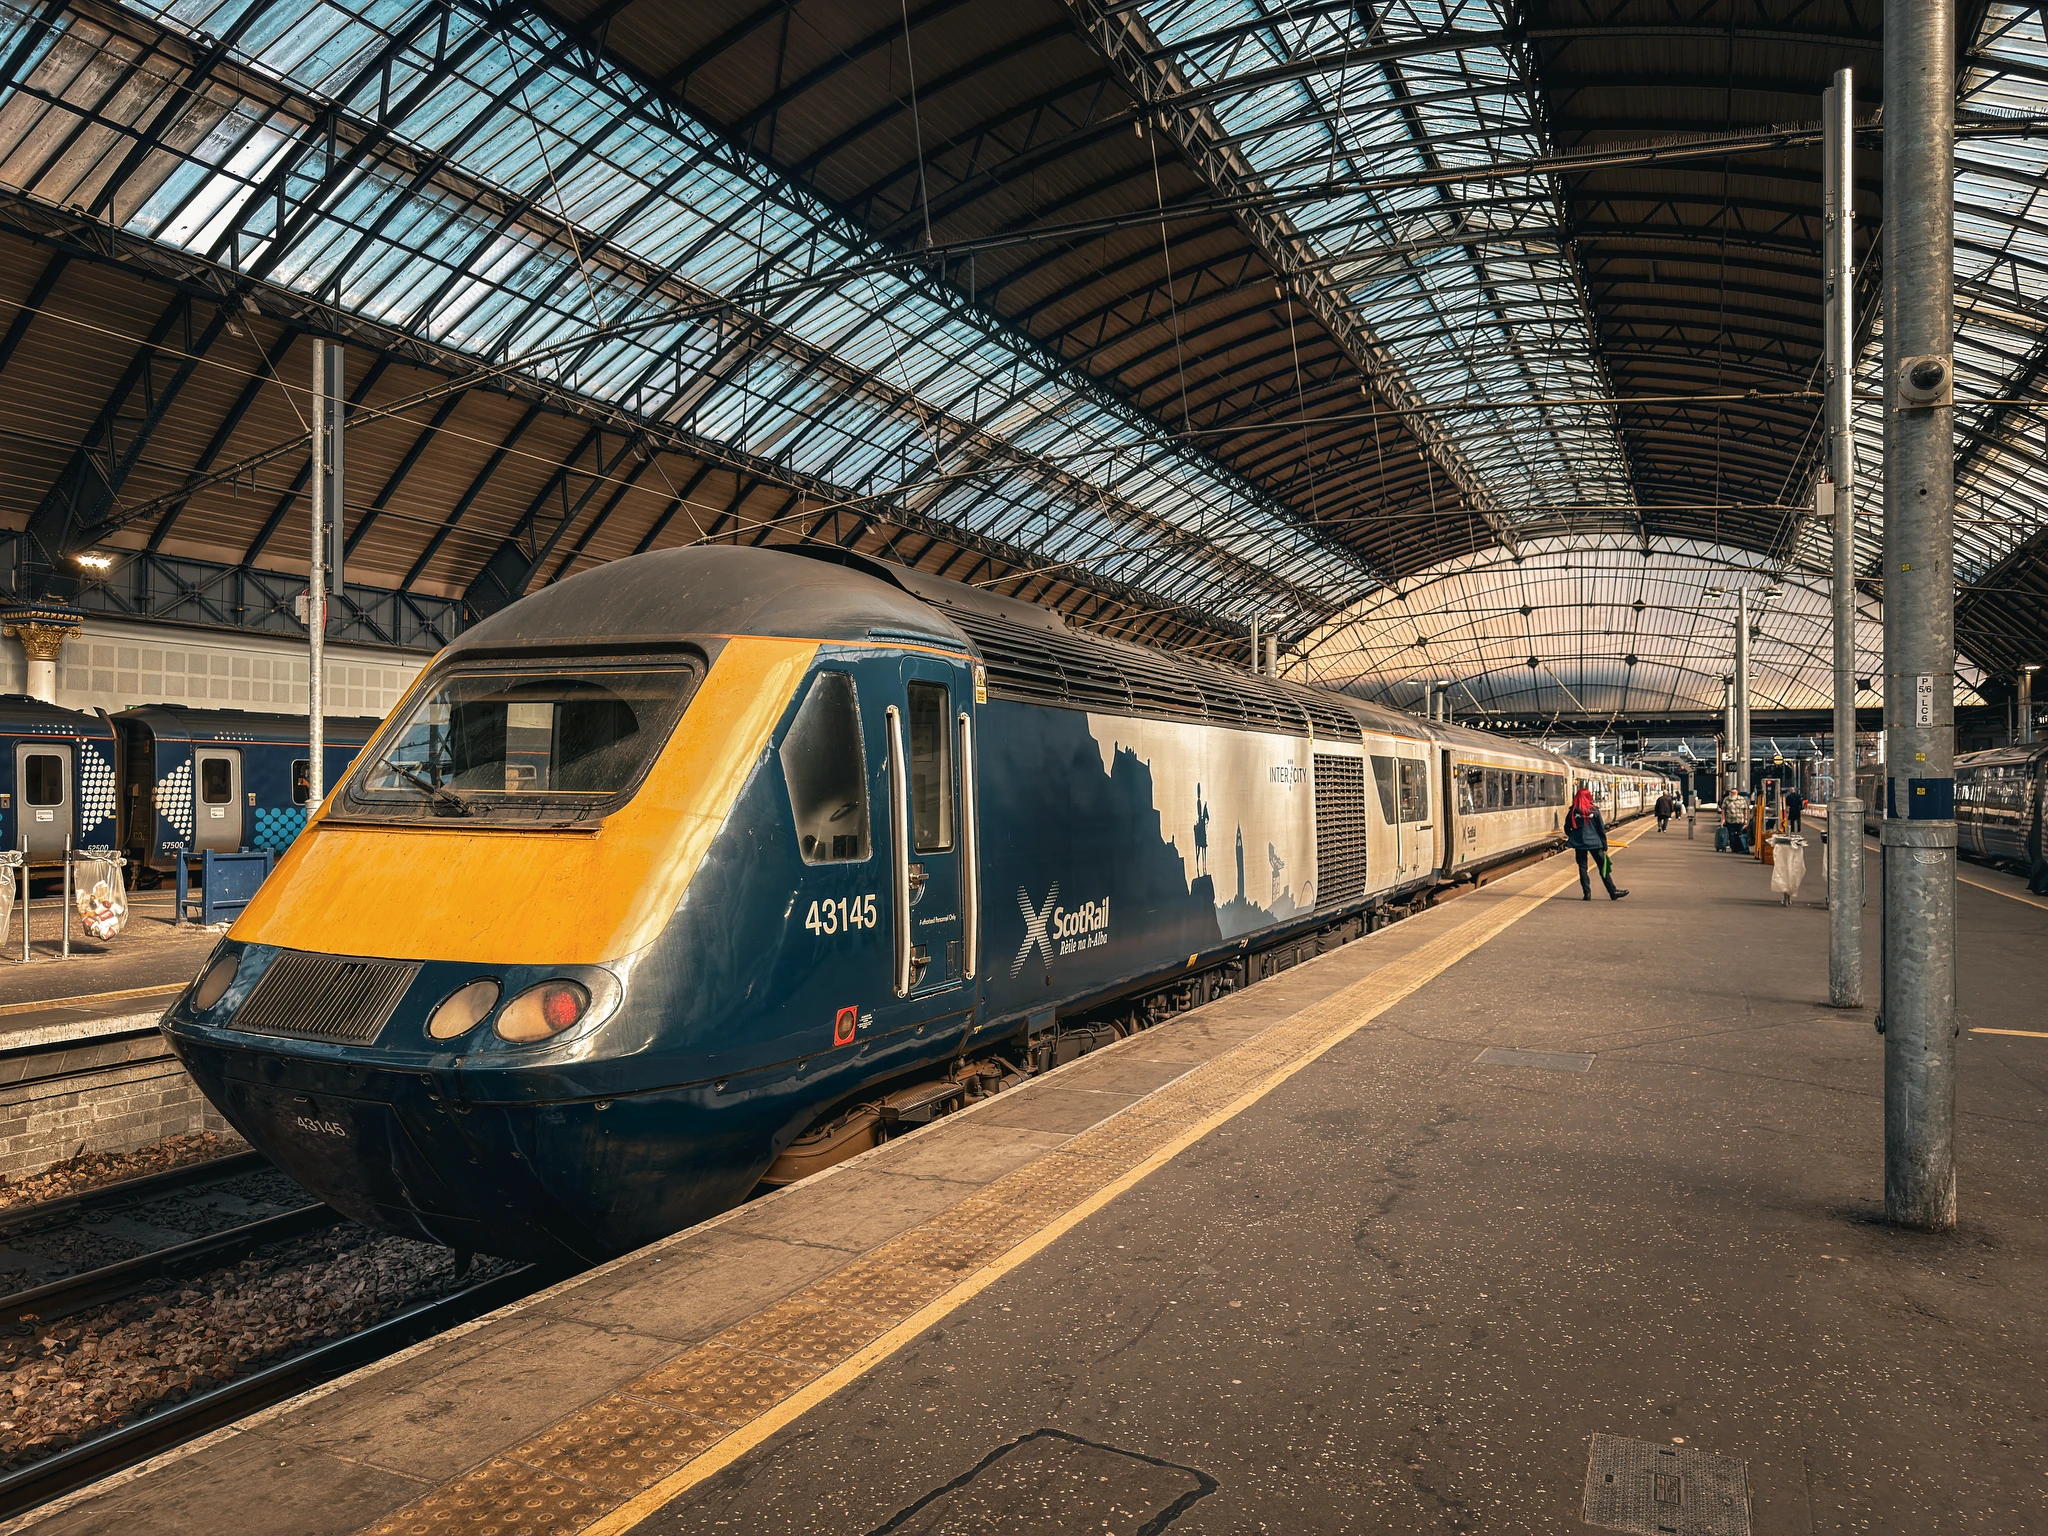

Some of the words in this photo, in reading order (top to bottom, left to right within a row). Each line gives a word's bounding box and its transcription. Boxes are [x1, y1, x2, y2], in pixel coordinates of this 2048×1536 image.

[162, 841, 184, 850] 57500
[805, 894, 877, 936] 43145
[1053, 896, 1110, 940] ScotRail
[297, 1116, 346, 1137] 43145
